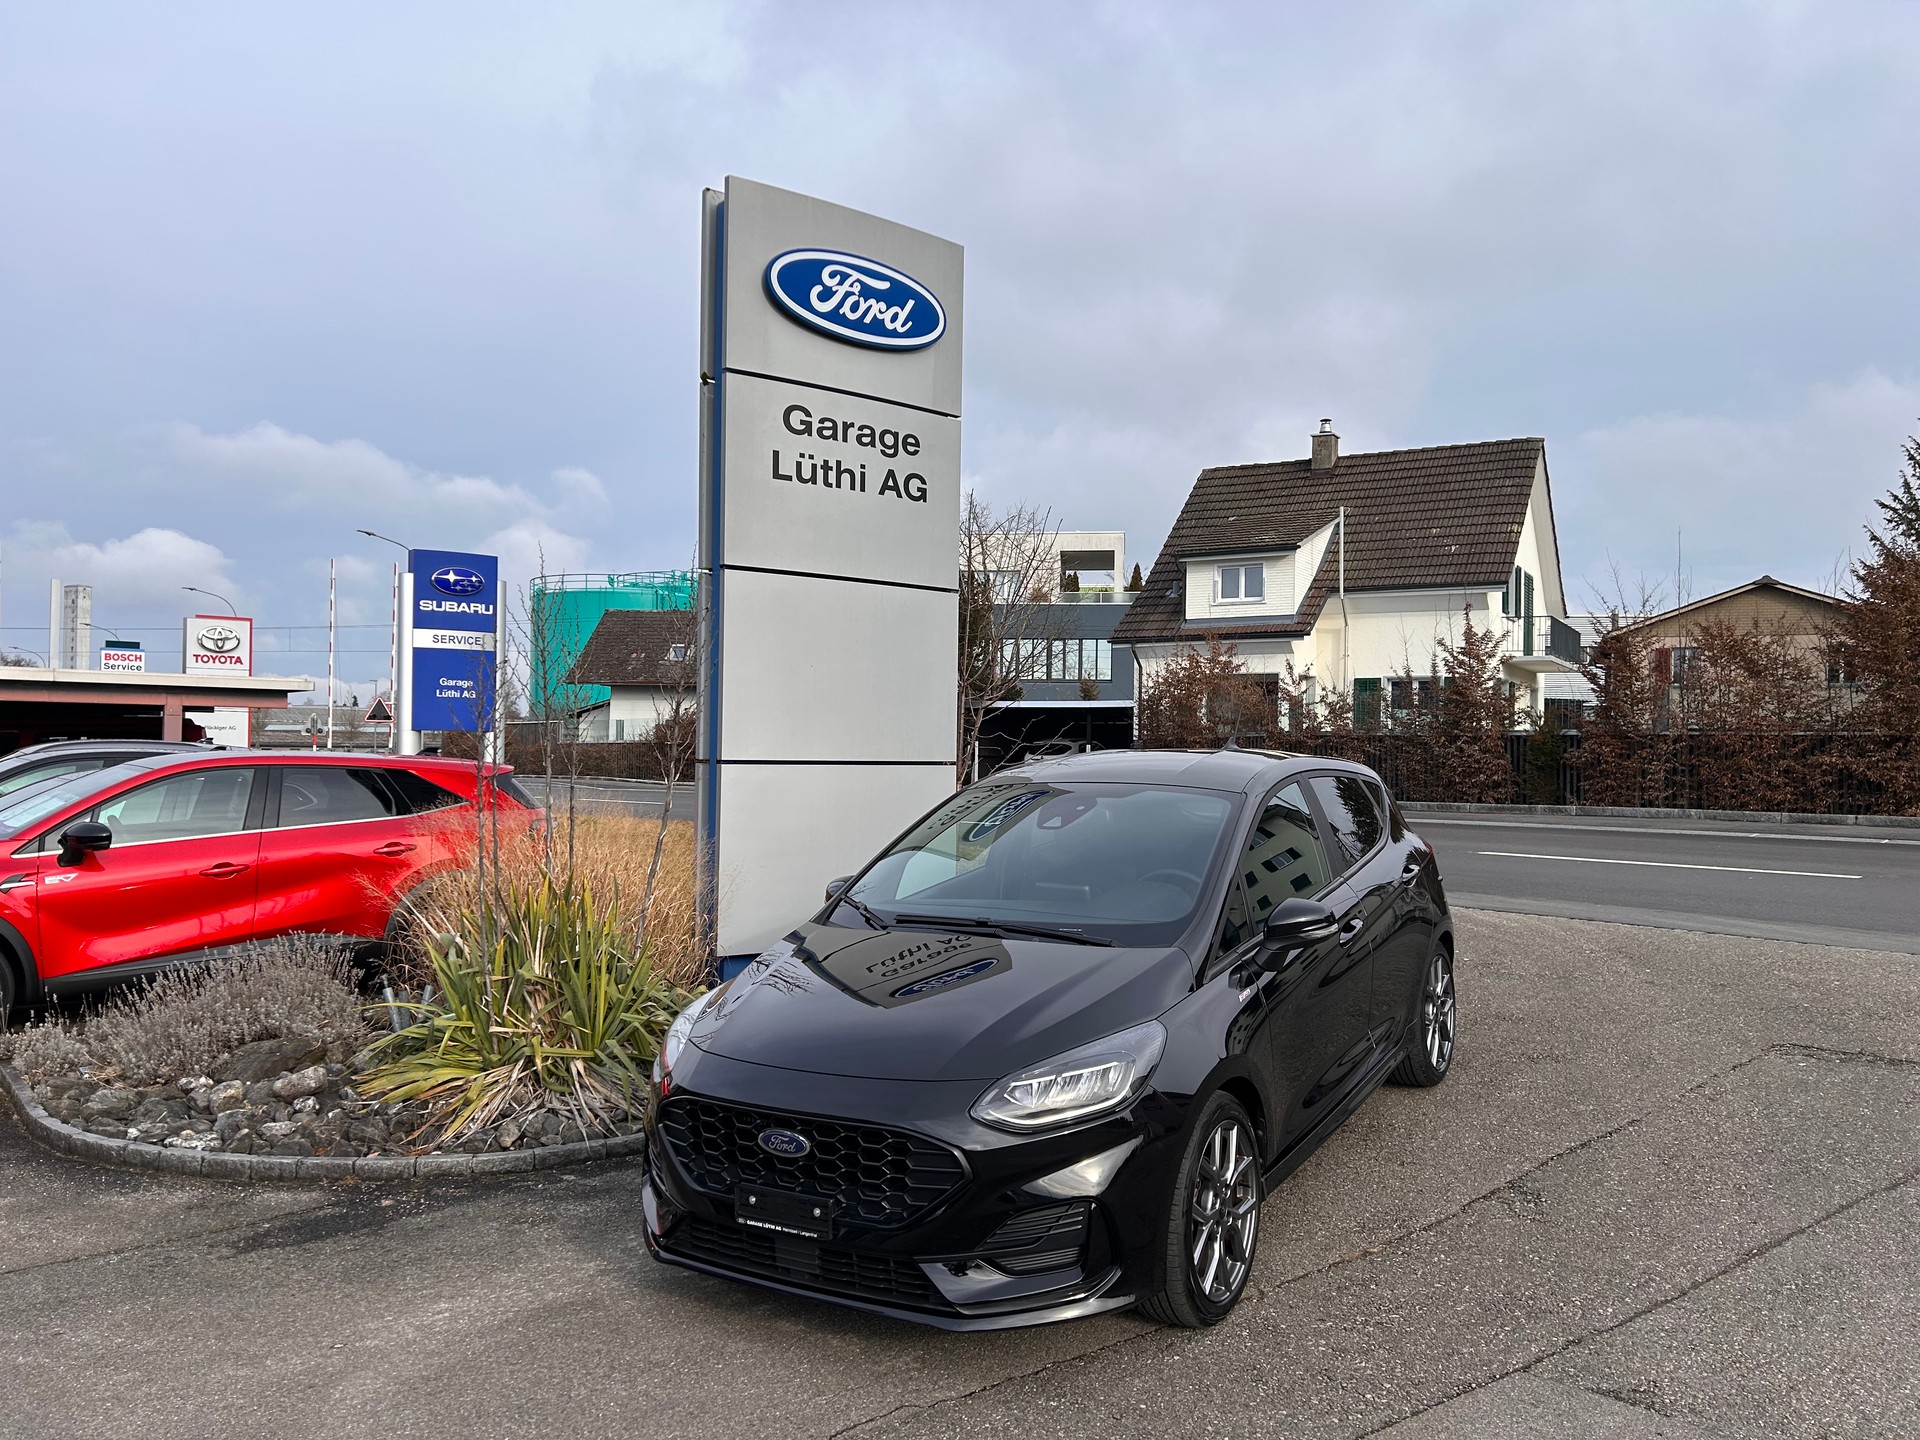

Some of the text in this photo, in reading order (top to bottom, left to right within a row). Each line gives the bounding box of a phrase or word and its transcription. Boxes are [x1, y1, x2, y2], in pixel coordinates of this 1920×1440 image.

[809, 264, 914, 333] Ford
[782, 404, 921, 458] Garage
[772, 449, 929, 503] Lüthi AG
[419, 600, 493, 614] SUBARU
[432, 634, 482, 645] SERVICE
[104, 652, 142, 662] BOSCH
[193, 654, 243, 665] TOYOTA
[104, 663, 142, 671] Service
[439, 678, 473, 688] Garage
[436, 689, 476, 698] Lüthi AG
[769, 1135, 796, 1152] Ford
